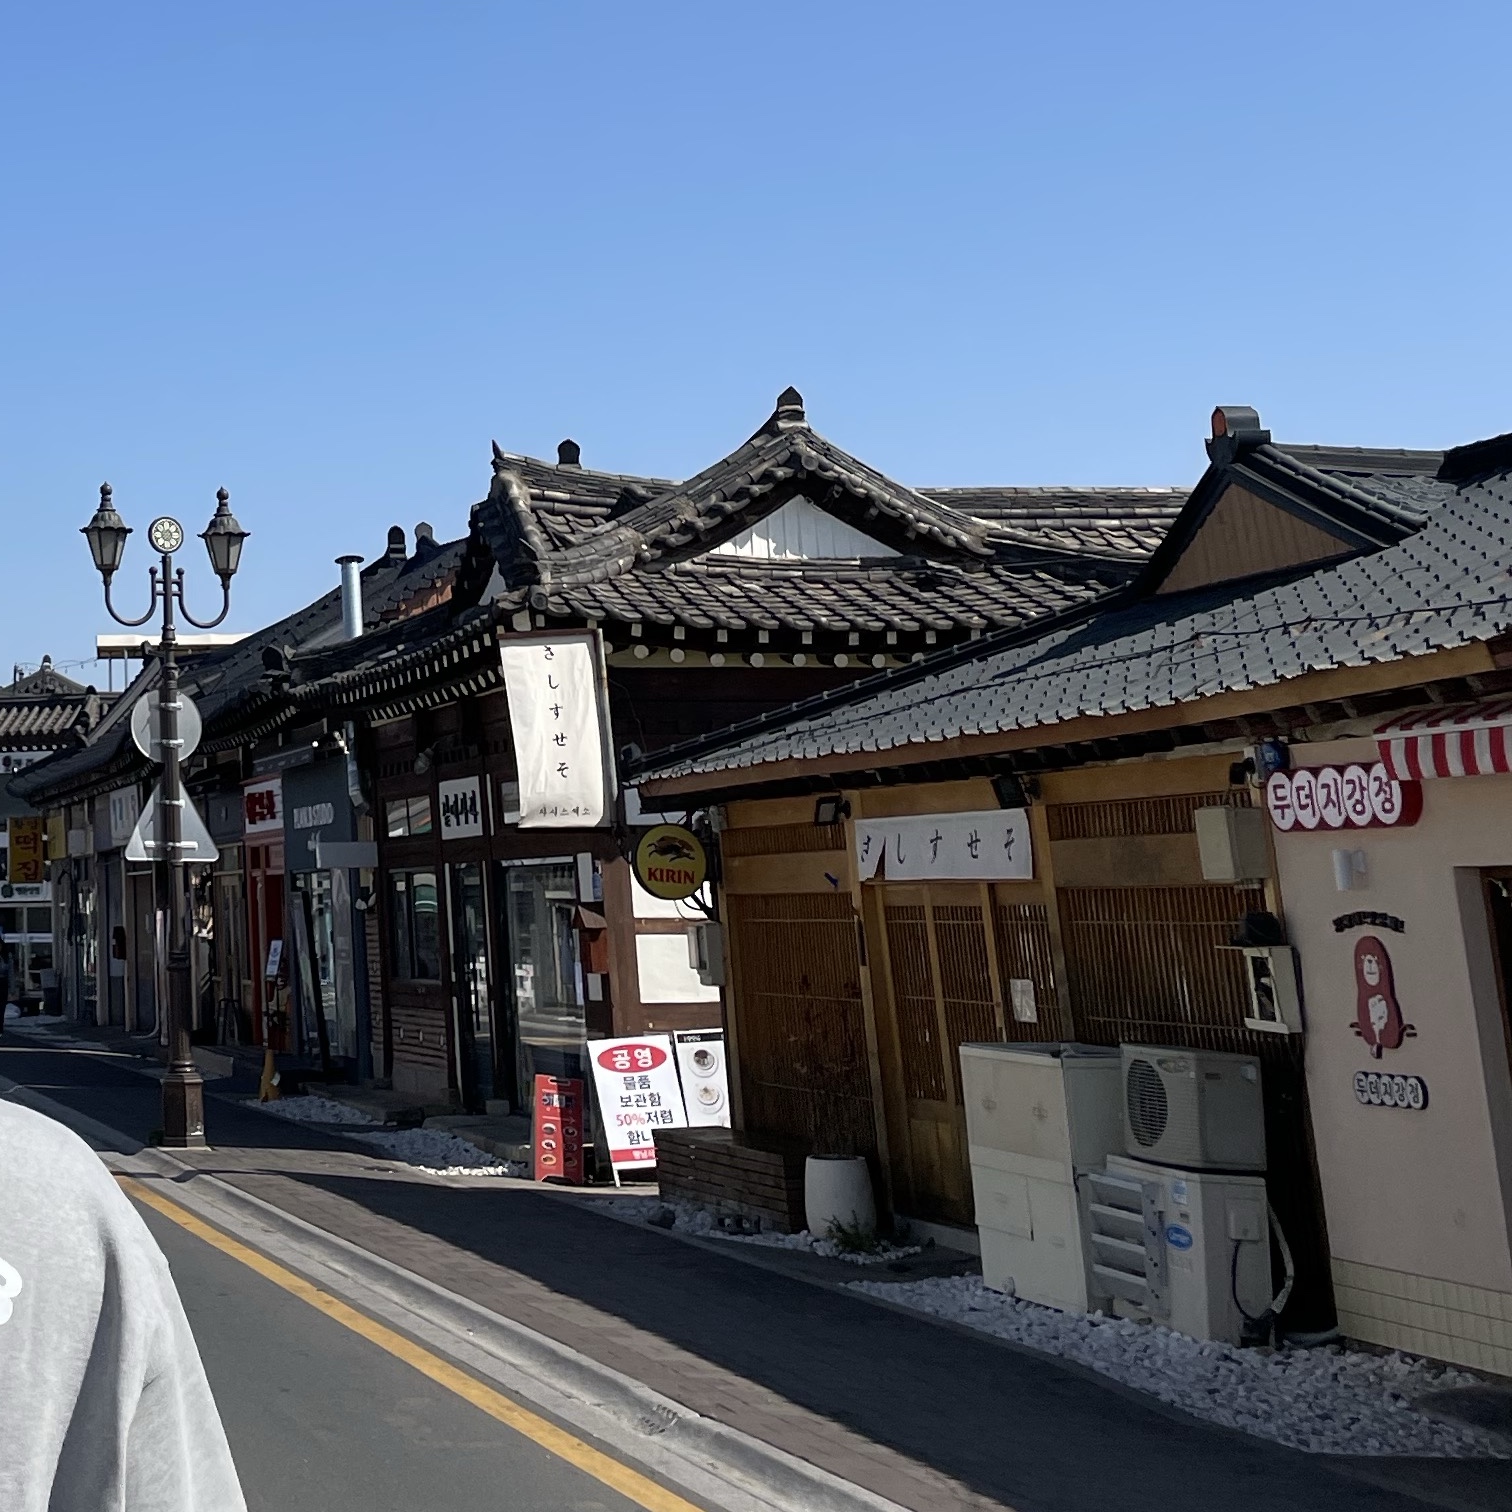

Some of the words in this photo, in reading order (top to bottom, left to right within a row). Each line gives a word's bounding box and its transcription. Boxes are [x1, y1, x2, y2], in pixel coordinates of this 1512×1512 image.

[543, 645, 570, 778] さしすせそ
[1272, 771, 1396, 821] 두더지강정
[859, 827, 1015, 865] さしすせそ
[647, 866, 696, 885] KIRIN
[612, 1048, 653, 1070] 공영
[622, 1075, 651, 1090] 물품
[619, 1092, 662, 1108] 보관함
